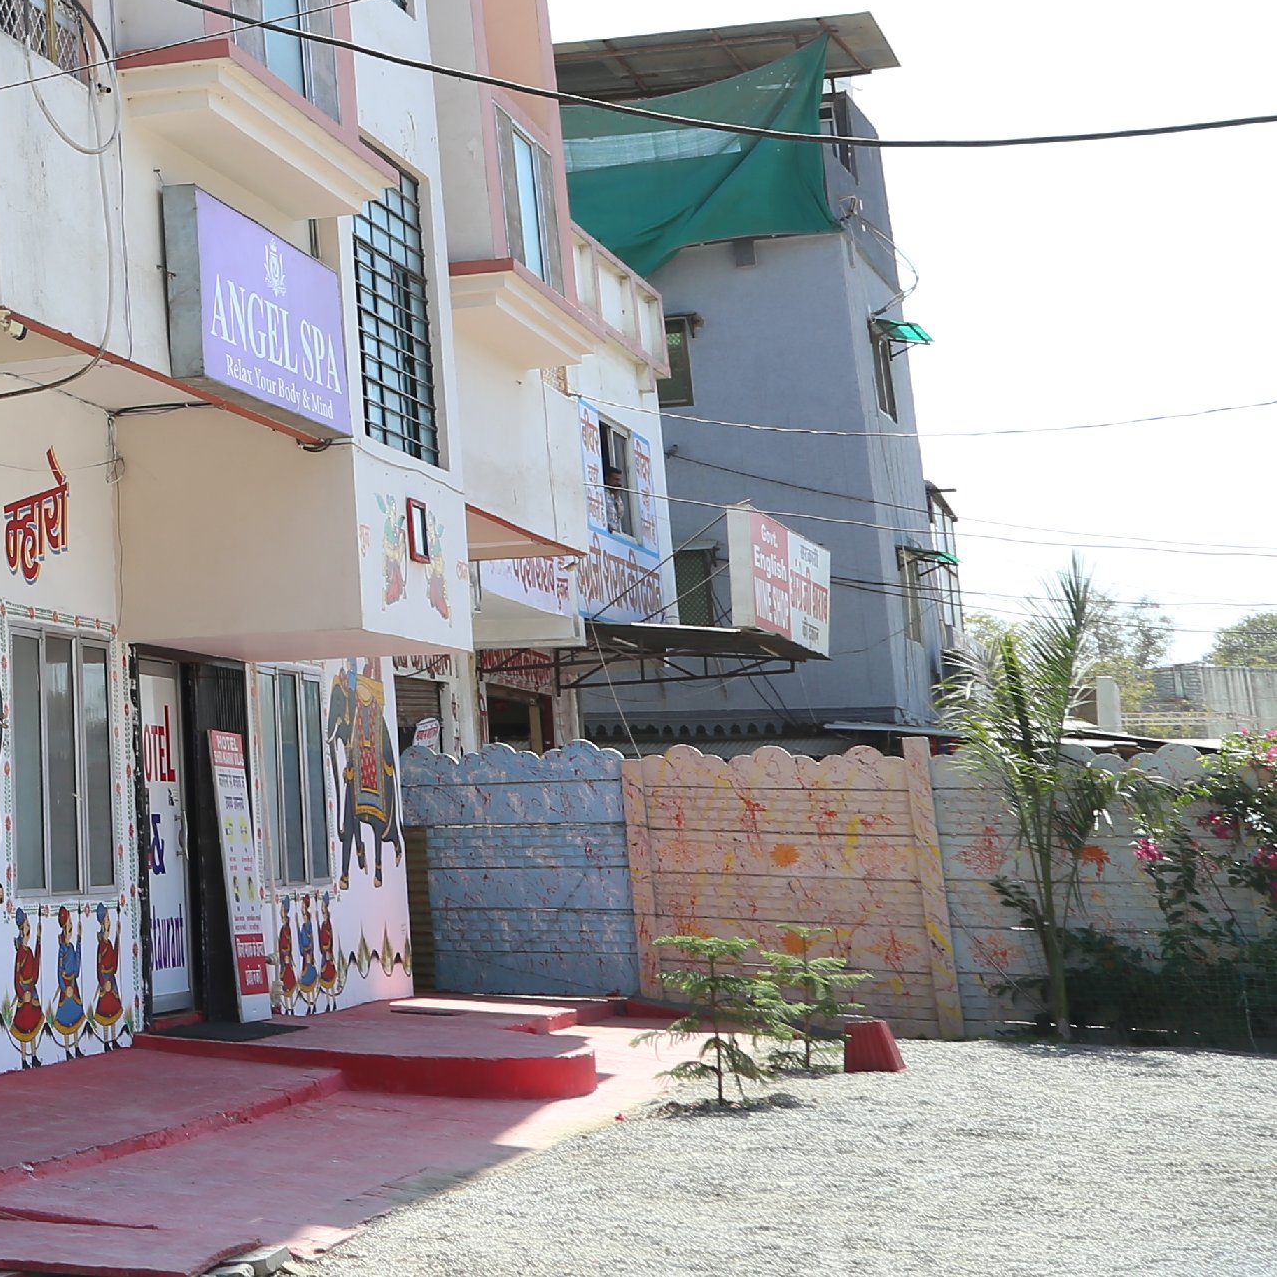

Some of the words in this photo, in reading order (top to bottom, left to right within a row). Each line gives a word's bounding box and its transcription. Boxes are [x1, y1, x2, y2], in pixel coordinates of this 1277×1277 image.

[211, 274, 298, 374] ANGEL
[300, 319, 342, 395] SPA
[226, 354, 253, 386] Relax
[254, 366, 276, 395] Your
[278, 380, 300, 411] Body
[302, 391, 312, 410] &
[312, 397, 334, 419] Mind
[753, 544, 788, 582] English
[761, 524, 778, 549] Govt.
[143, 704, 176, 782] OTEL
[216, 735, 239, 752] HOTEL
[151, 814, 166, 875] &
[150, 904, 185, 972] taurant
